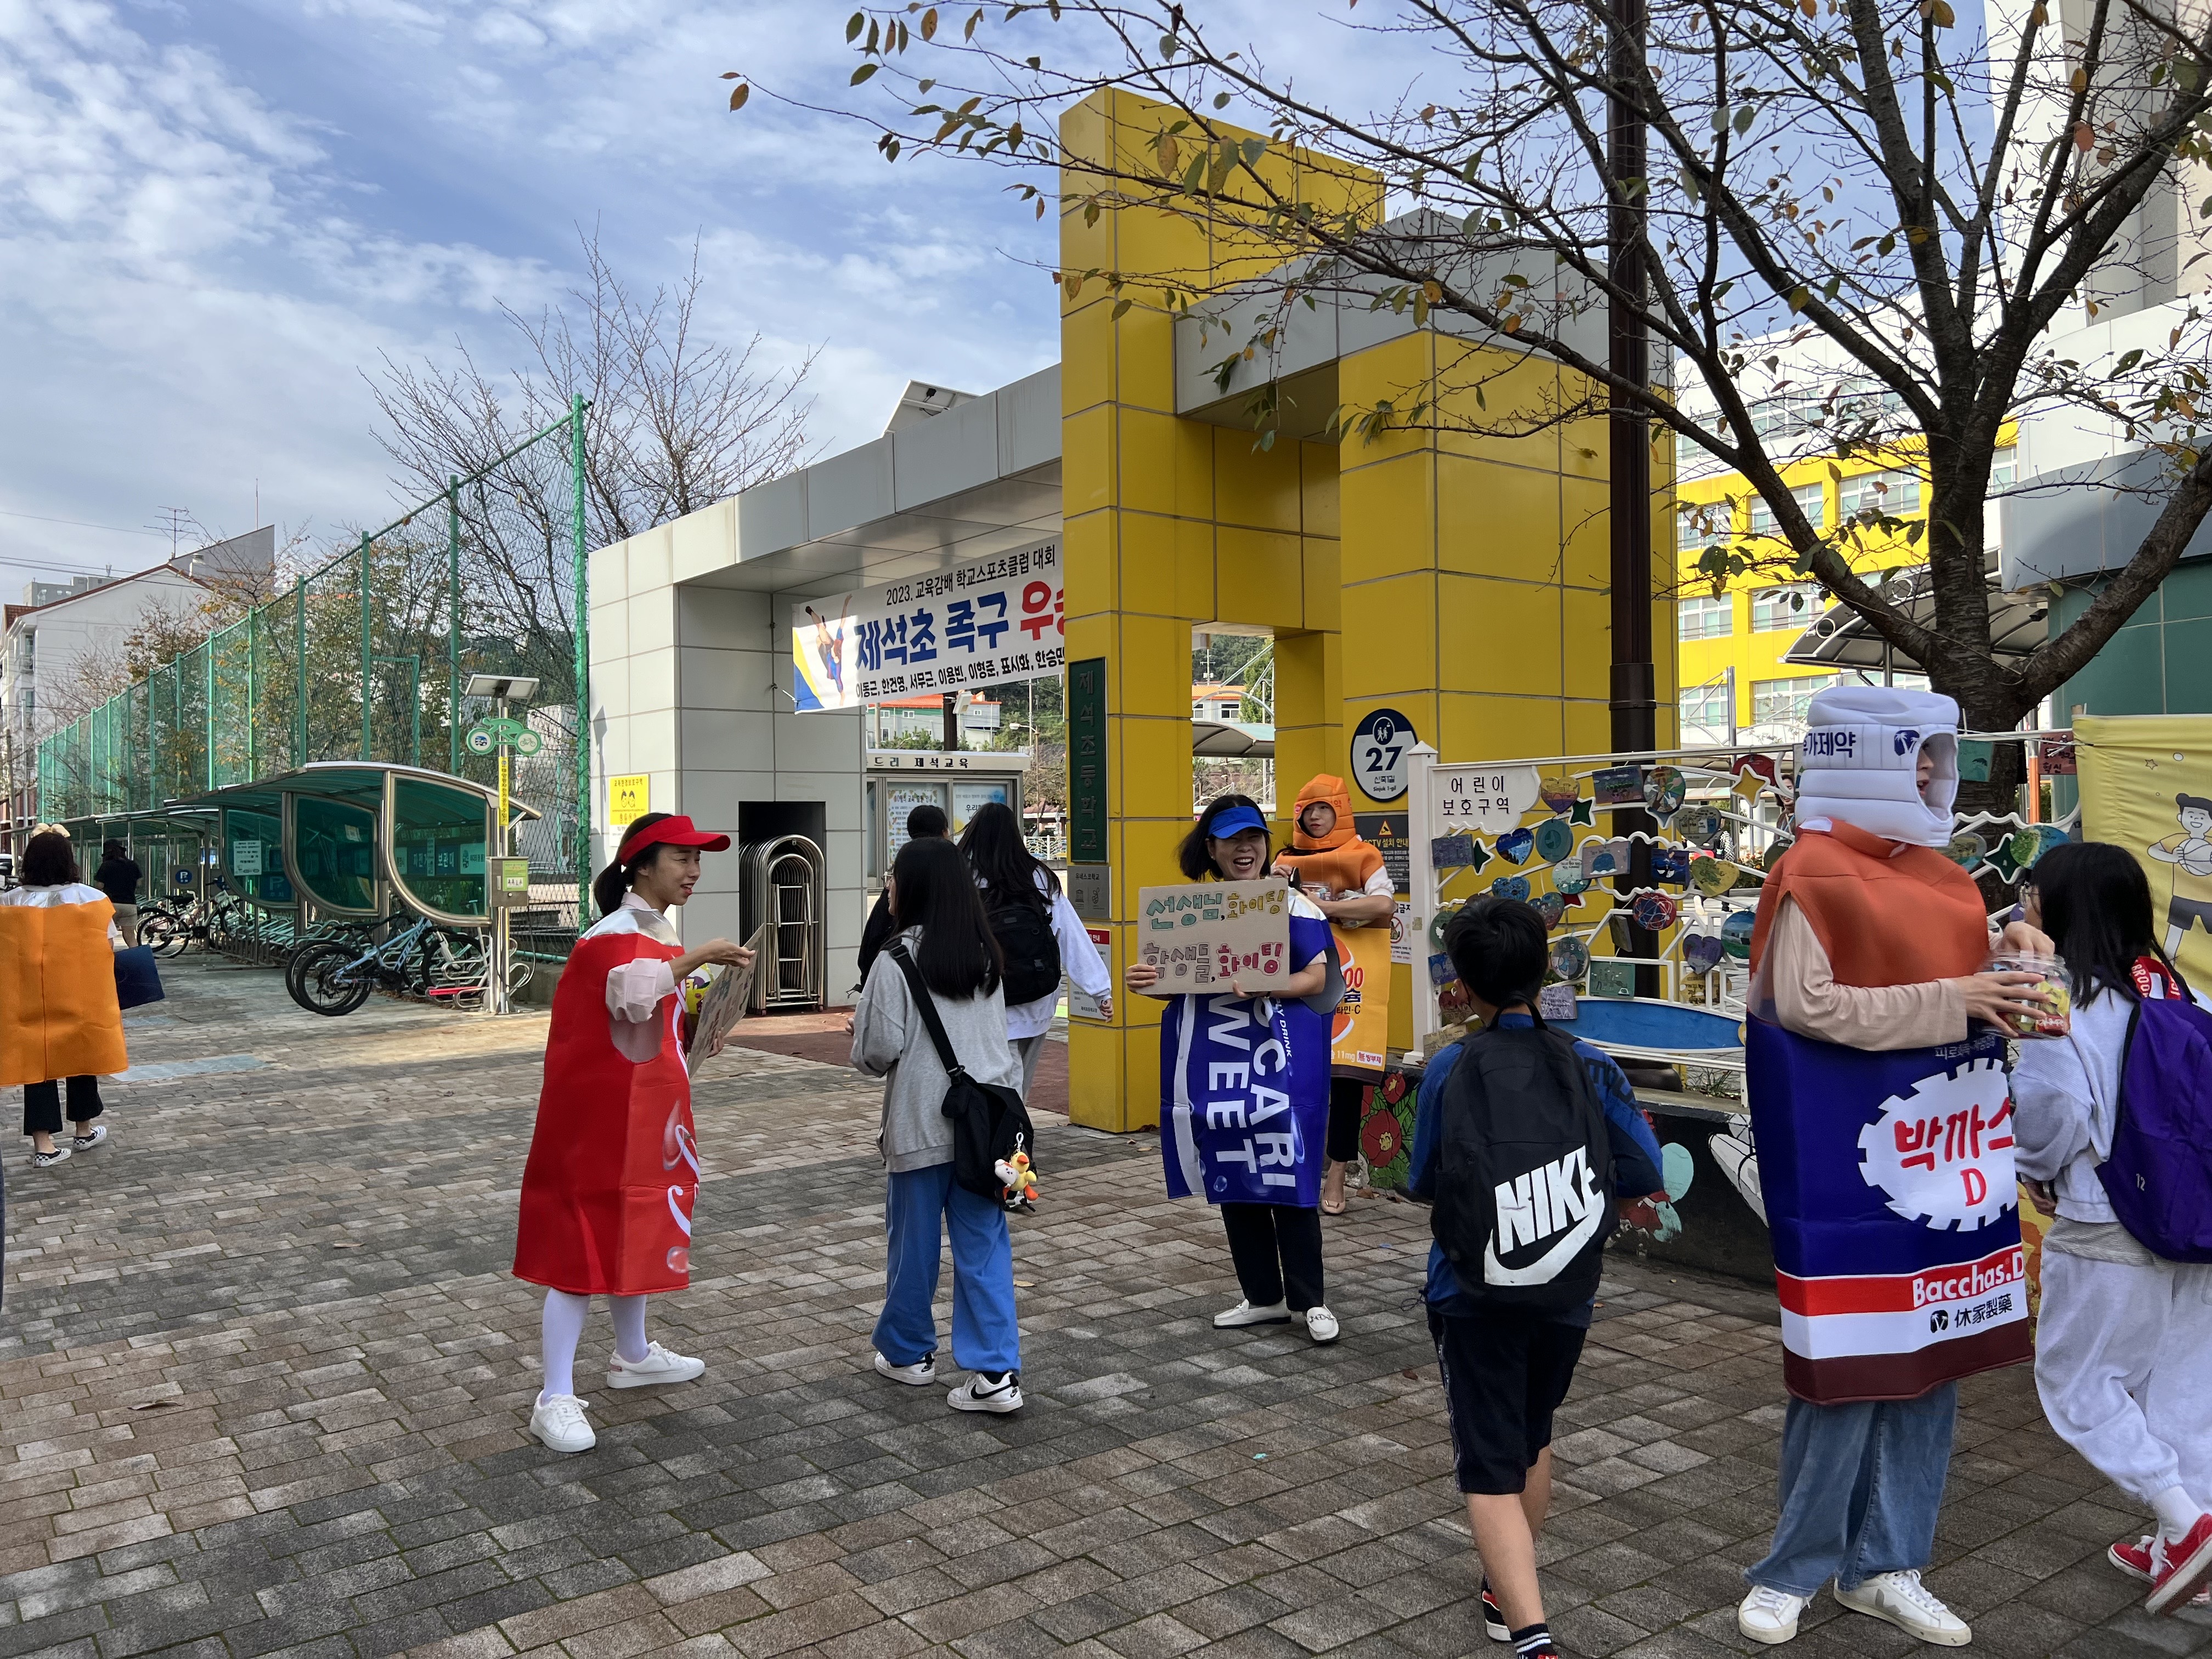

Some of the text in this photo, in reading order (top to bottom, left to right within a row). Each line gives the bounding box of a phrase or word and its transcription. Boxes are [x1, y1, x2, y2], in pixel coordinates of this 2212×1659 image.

[887, 544, 1056, 606] 2023. 교육감배 학교스포츠클럽 대회
[855, 608, 937, 670] 제석초
[945, 591, 1009, 653] 족구
[856, 680, 880, 698] 이동근,
[910, 670, 937, 690] 서무근,
[938, 665, 967, 685] 이용빈,
[968, 660, 999, 679] 이형준,
[866, 757, 968, 768] 드리 제석교육
[1079, 669, 1097, 851] 제석초등학교
[1365, 746, 1403, 772] 27
[1451, 775, 1504, 794] 어린이
[1443, 797, 1510, 815] 보호구역
[1382, 838, 1395, 848] 설치
[1396, 838, 1409, 848] 안내
[1227, 889, 1285, 918] 화이팅
[1218, 943, 1282, 977] 화이팅
[1342, 988, 1361, 1003] 슘
[1279, 1019, 1293, 1058] DRINK
[1960, 1167, 1987, 1206] D
